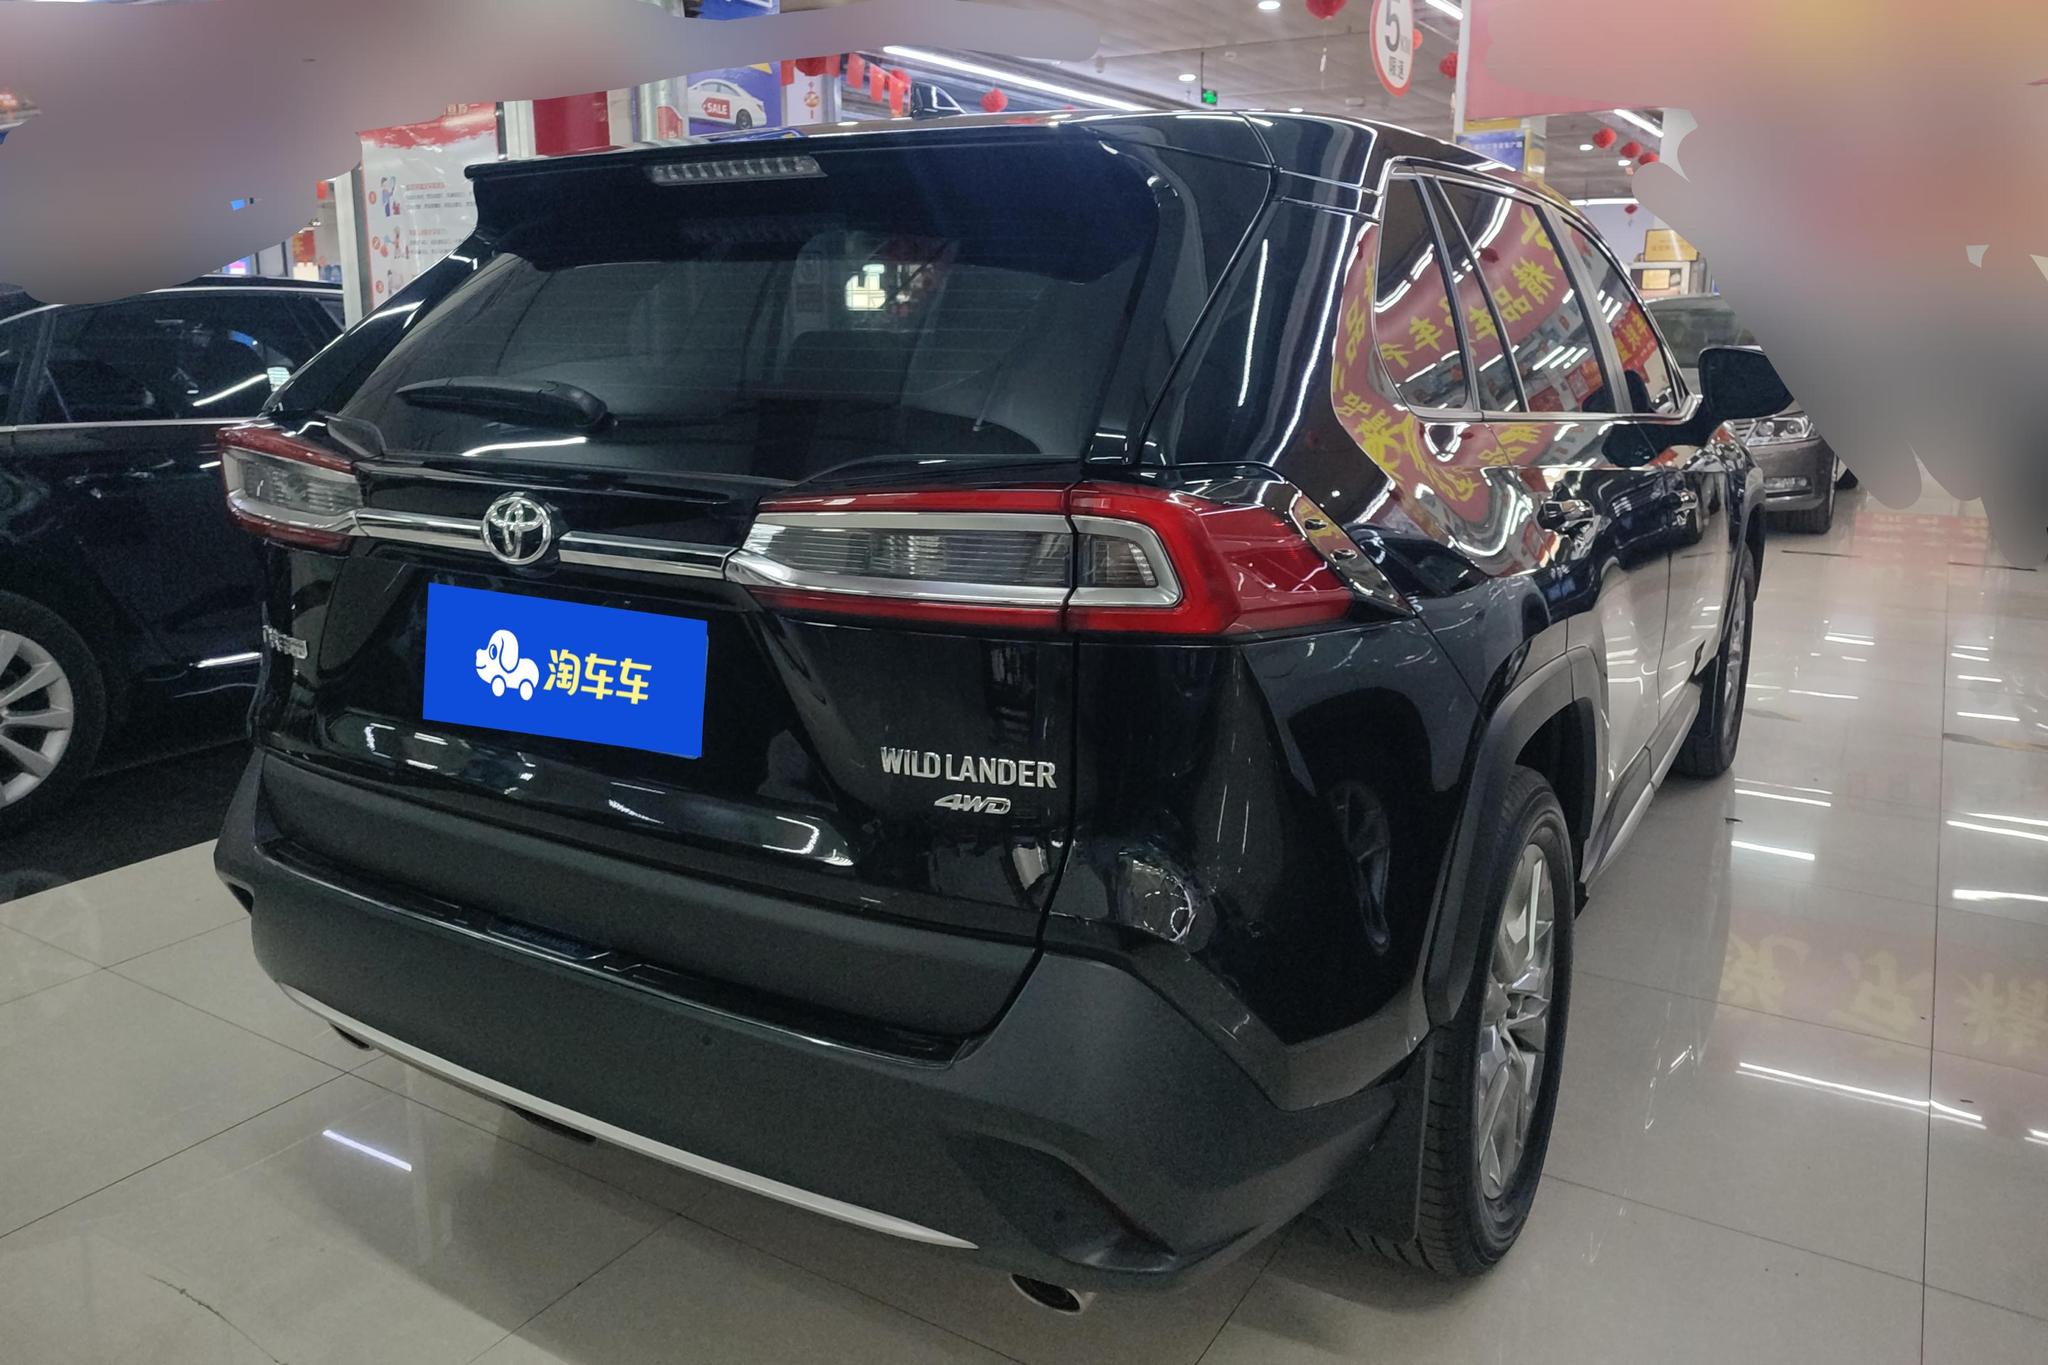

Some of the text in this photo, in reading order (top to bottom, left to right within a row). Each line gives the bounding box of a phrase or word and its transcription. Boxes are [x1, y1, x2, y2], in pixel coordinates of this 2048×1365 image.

[1385, 0, 1400, 52] 5
[706, 102, 727, 115] SALE
[934, 793, 1011, 815] 4WD
